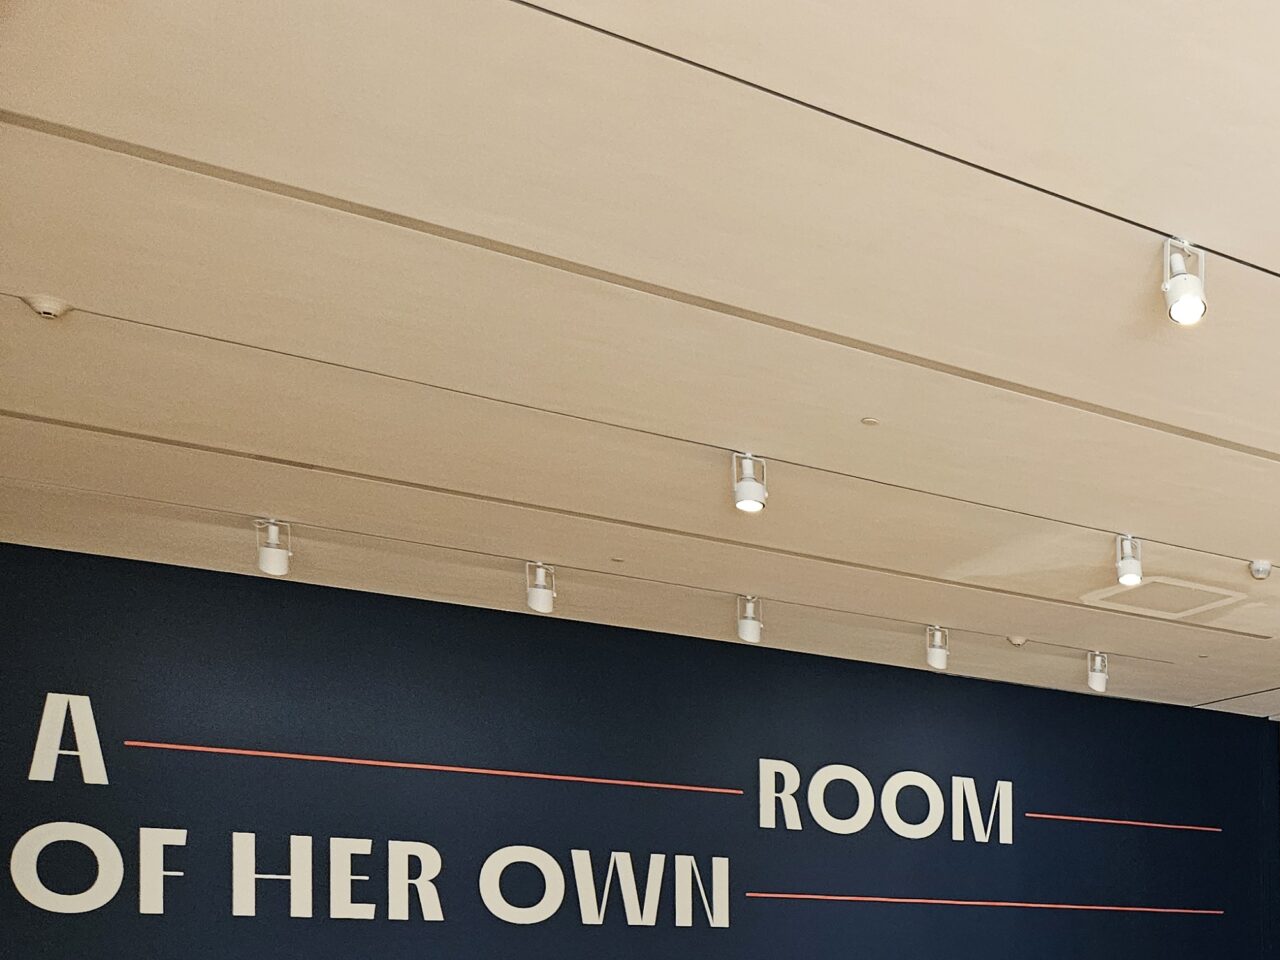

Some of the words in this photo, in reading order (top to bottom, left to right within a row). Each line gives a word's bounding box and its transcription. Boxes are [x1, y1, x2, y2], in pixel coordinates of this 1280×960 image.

[29, 693, 108, 784] A
[759, 759, 1012, 844] ROOM
[11, 822, 187, 914] OF
[233, 832, 444, 921] HER
[479, 846, 729, 927] OWN
